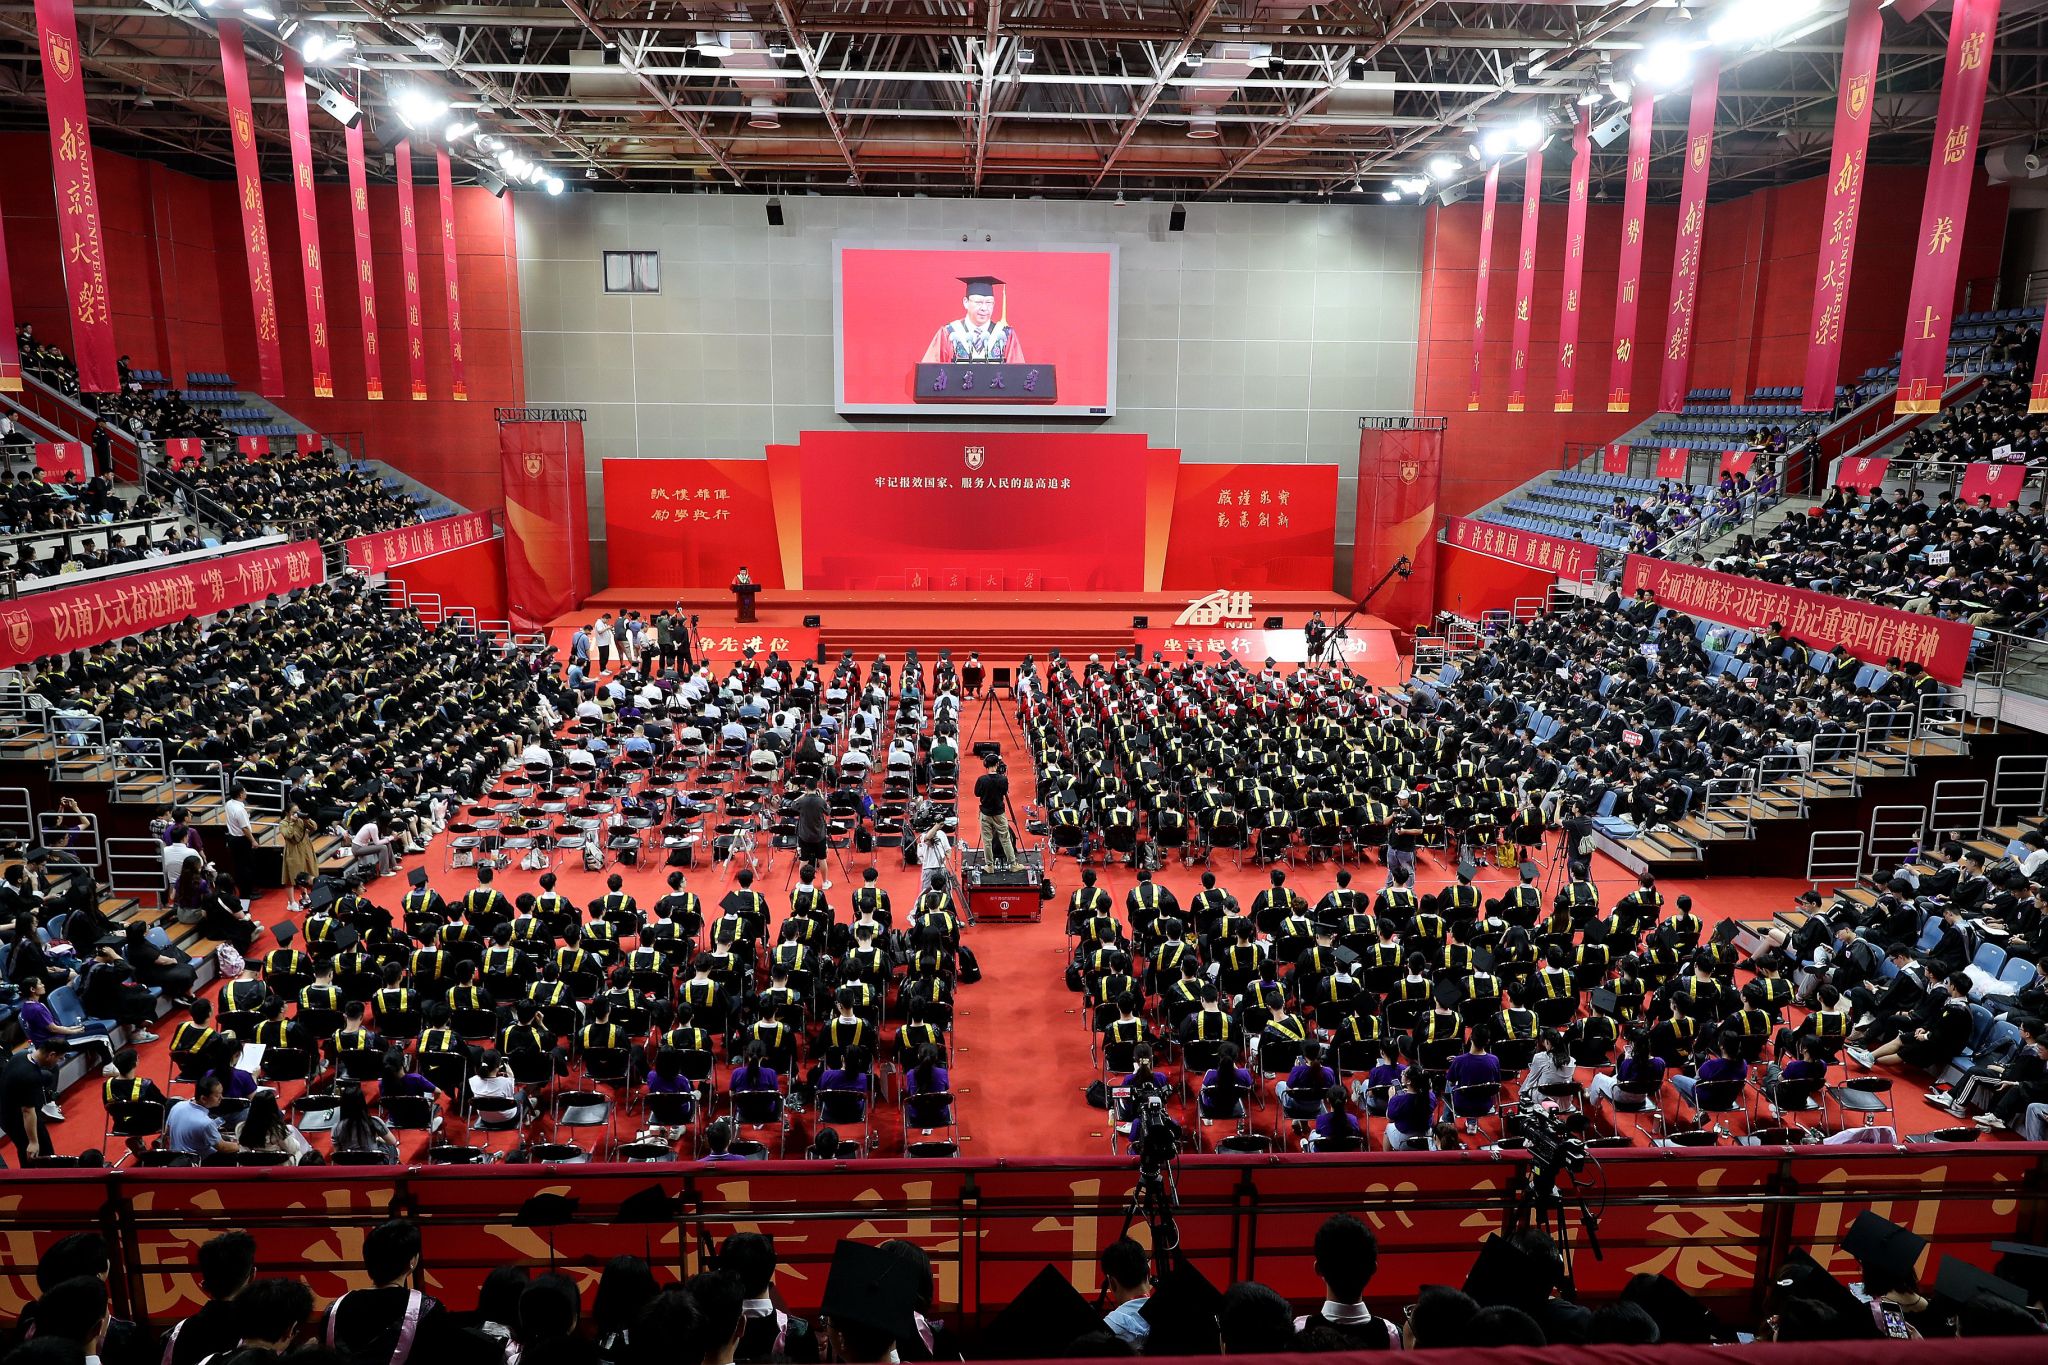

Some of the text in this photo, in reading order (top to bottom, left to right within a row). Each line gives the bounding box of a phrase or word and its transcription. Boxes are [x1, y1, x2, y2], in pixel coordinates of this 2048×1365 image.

[75, 122, 108, 325] NANJING UNIVERSITY
[1914, 31, 1985, 341] 宽德养士
[252, 178, 278, 341] NANJING UNIVERSITY
[1616, 156, 1646, 363] 应势而动
[1829, 148, 1863, 344] NANJING UNIVERSITY
[874, 476, 1071, 490] 牢记报效国家、服务人民的最高追求
[383, 516, 485, 563] 逐梦山海 再启新程
[1471, 525, 1581, 575] 许党报国 勇毅前行
[699, 635, 790, 653] 争先进位
[1163, 636, 1253, 655] 坐言起行
[1225, 621, 1253, 629] NJU
[1655, 567, 1940, 668] 全面贯彻落实习近平总书记重要回信精神
